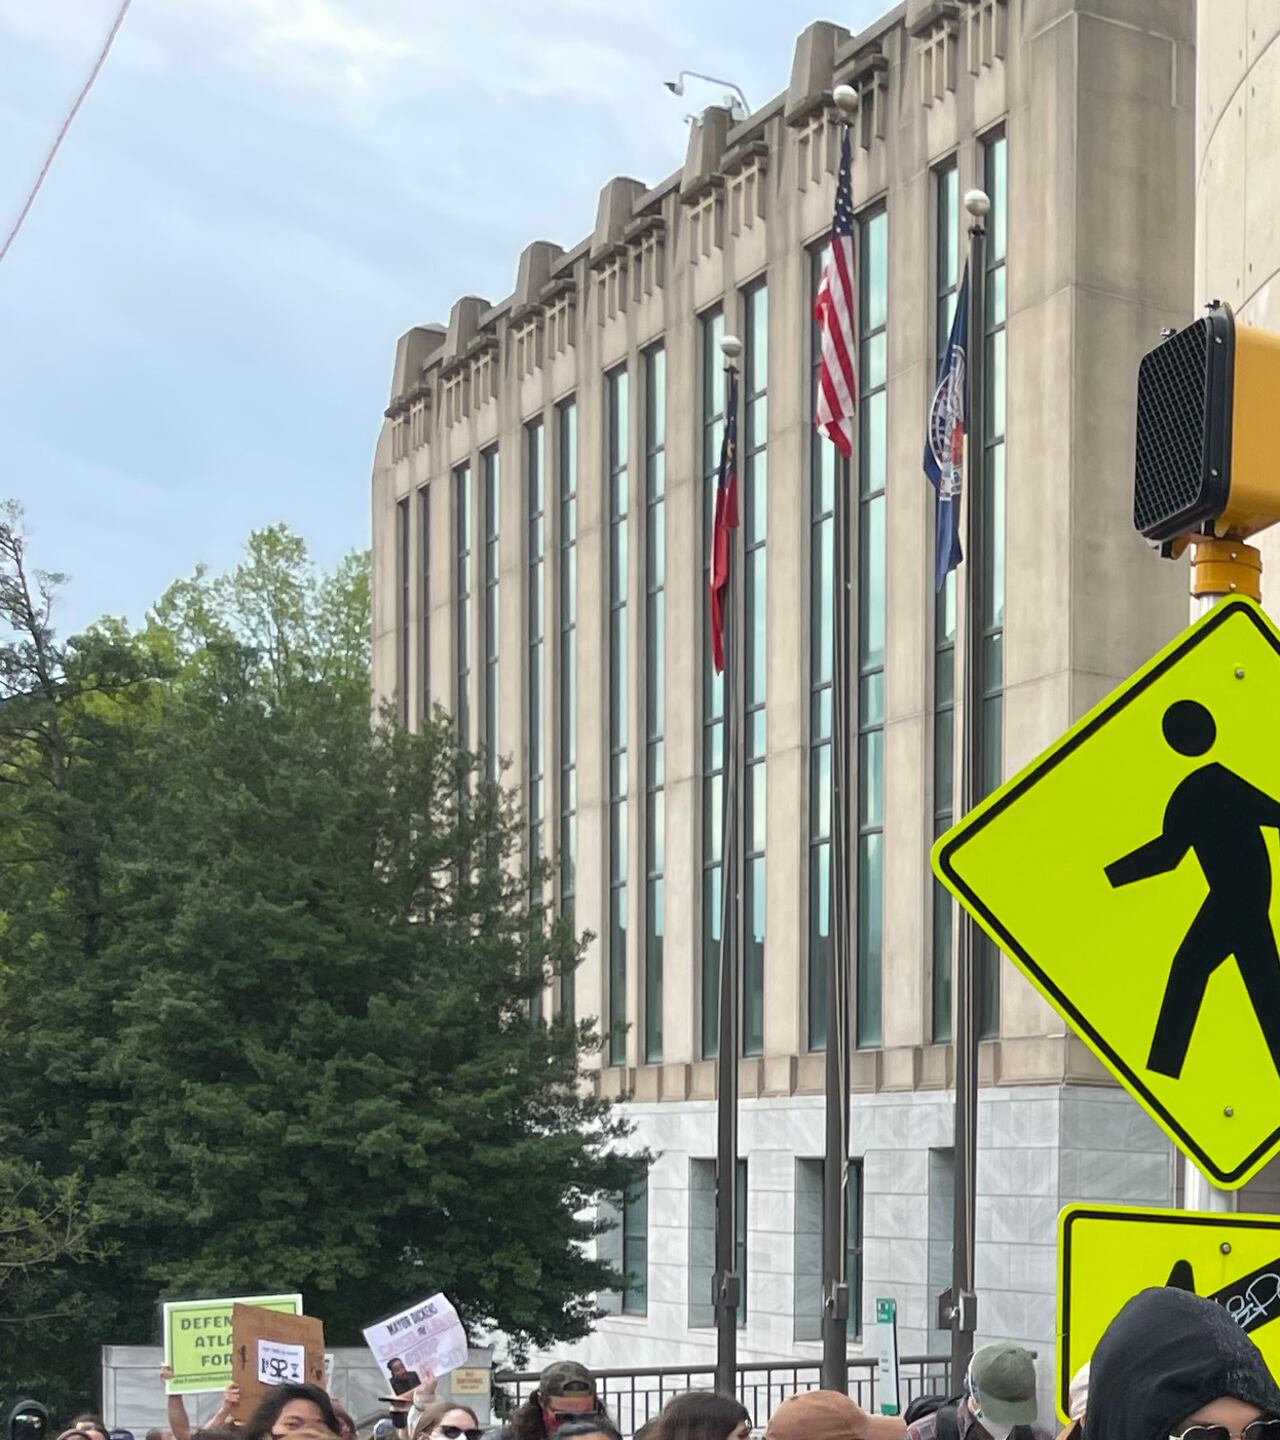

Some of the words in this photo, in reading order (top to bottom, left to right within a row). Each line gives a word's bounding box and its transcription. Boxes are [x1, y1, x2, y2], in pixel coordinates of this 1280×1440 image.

[181, 1316, 232, 1330] DEFEN
[195, 1335, 232, 1348] ATLA
[201, 1354, 232, 1367] FOR
